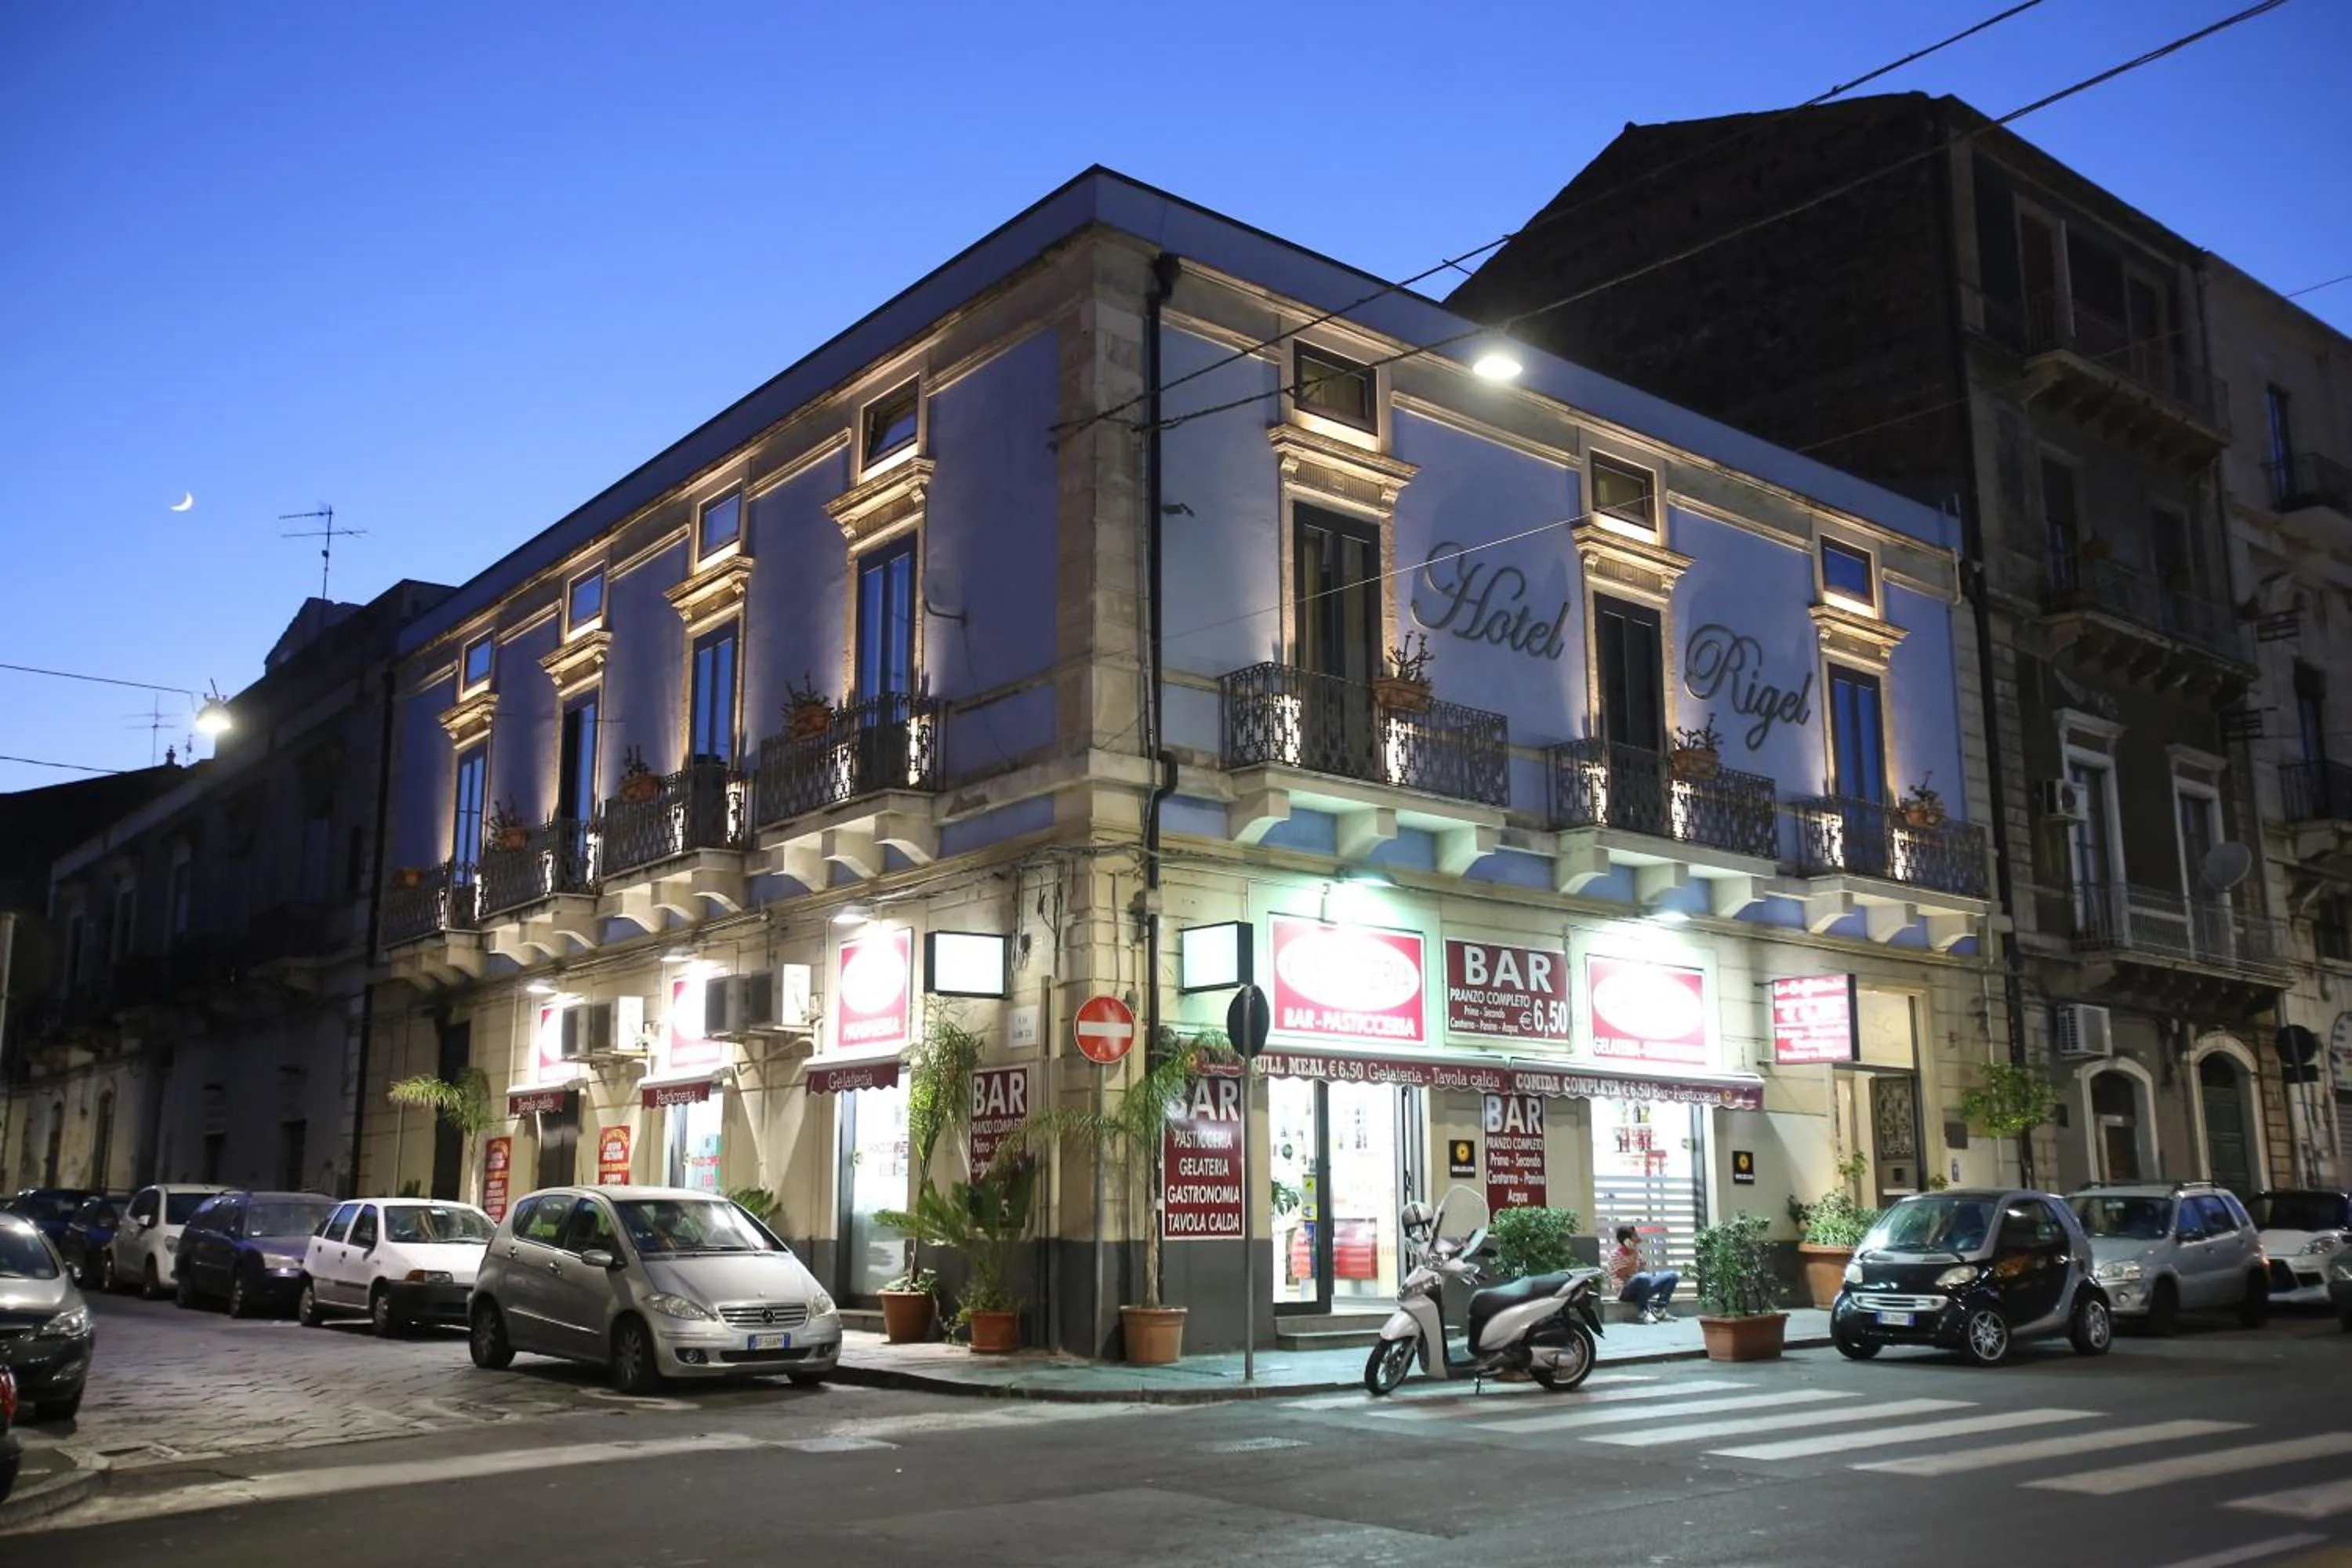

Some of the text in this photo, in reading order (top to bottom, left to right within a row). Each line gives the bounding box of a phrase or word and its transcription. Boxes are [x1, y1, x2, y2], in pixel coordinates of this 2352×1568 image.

[1411, 541, 1814, 751] Hotel Rigel
[1464, 945, 1553, 993] BAR
[1450, 988, 1531, 1008] PRANZO COMPLETO
[828, 1069, 873, 1089] Gelateria
[1288, 1056, 1327, 1076] MEAL
[1368, 1062, 1423, 1083] Gelateria
[1432, 1067, 1468, 1087] Tavola
[1470, 1070, 1500, 1087] calda
[972, 1071, 1026, 1117] BAR
[1515, 1073, 1560, 1092] COMIDA
[1563, 1076, 1621, 1096] COMPLETA
[1486, 1094, 1542, 1134] BAR
[1174, 1130, 1233, 1149] PASTICCERIA
[1486, 1136, 1544, 1151] PRANZO COMPLETO
[1179, 1157, 1230, 1177] GELATERIA
[1490, 1152, 1509, 1167] Primo
[1515, 1152, 1541, 1167] Secondo
[1167, 1185, 1240, 1204] GASTRONOMIA
[1507, 1189, 1529, 1207] Acqua
[1168, 1212, 1240, 1232] TAVOLA CALDA
